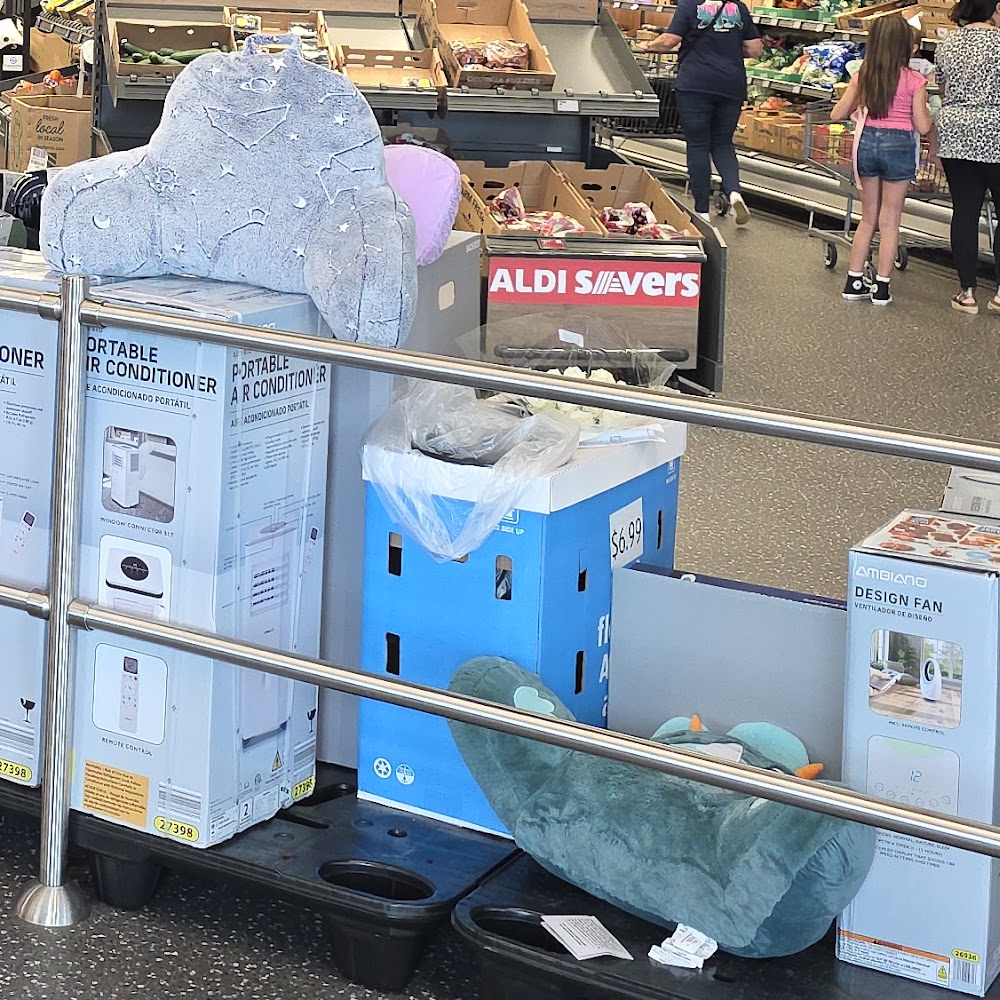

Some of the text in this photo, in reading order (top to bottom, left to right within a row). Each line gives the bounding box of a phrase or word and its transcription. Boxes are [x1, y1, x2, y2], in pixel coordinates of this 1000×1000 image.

[36, 118, 65, 135] local
[490, 268, 567, 294] ALDI
[87, 336, 159, 364] ORTABLE
[86, 355, 217, 395] IR CONDITIONER
[232, 355, 289, 383] PORTABLE
[92, 384, 191, 410] ACONDICIONADO PORTÁTIL
[243, 405, 287, 425] ACONDICIONADO
[287, 398, 310, 413] PORTÁTIL
[100, 516, 126, 527] WINDOW
[127, 522, 163, 535] CONNECTOR
[611, 517, 643, 559] $6.99
[855, 565, 928, 588] AMBIANO
[855, 586, 909, 607] DESIGN
[914, 596, 943, 614] FAN
[854, 602, 896, 616] VENTILADOR
[907, 612, 933, 623] DISEÑO
[101, 737, 153, 757] REMOTE CONTROL
[910, 770, 922, 783] 12
[243, 803, 249, 817] 2
[159, 819, 194, 839] 27398
